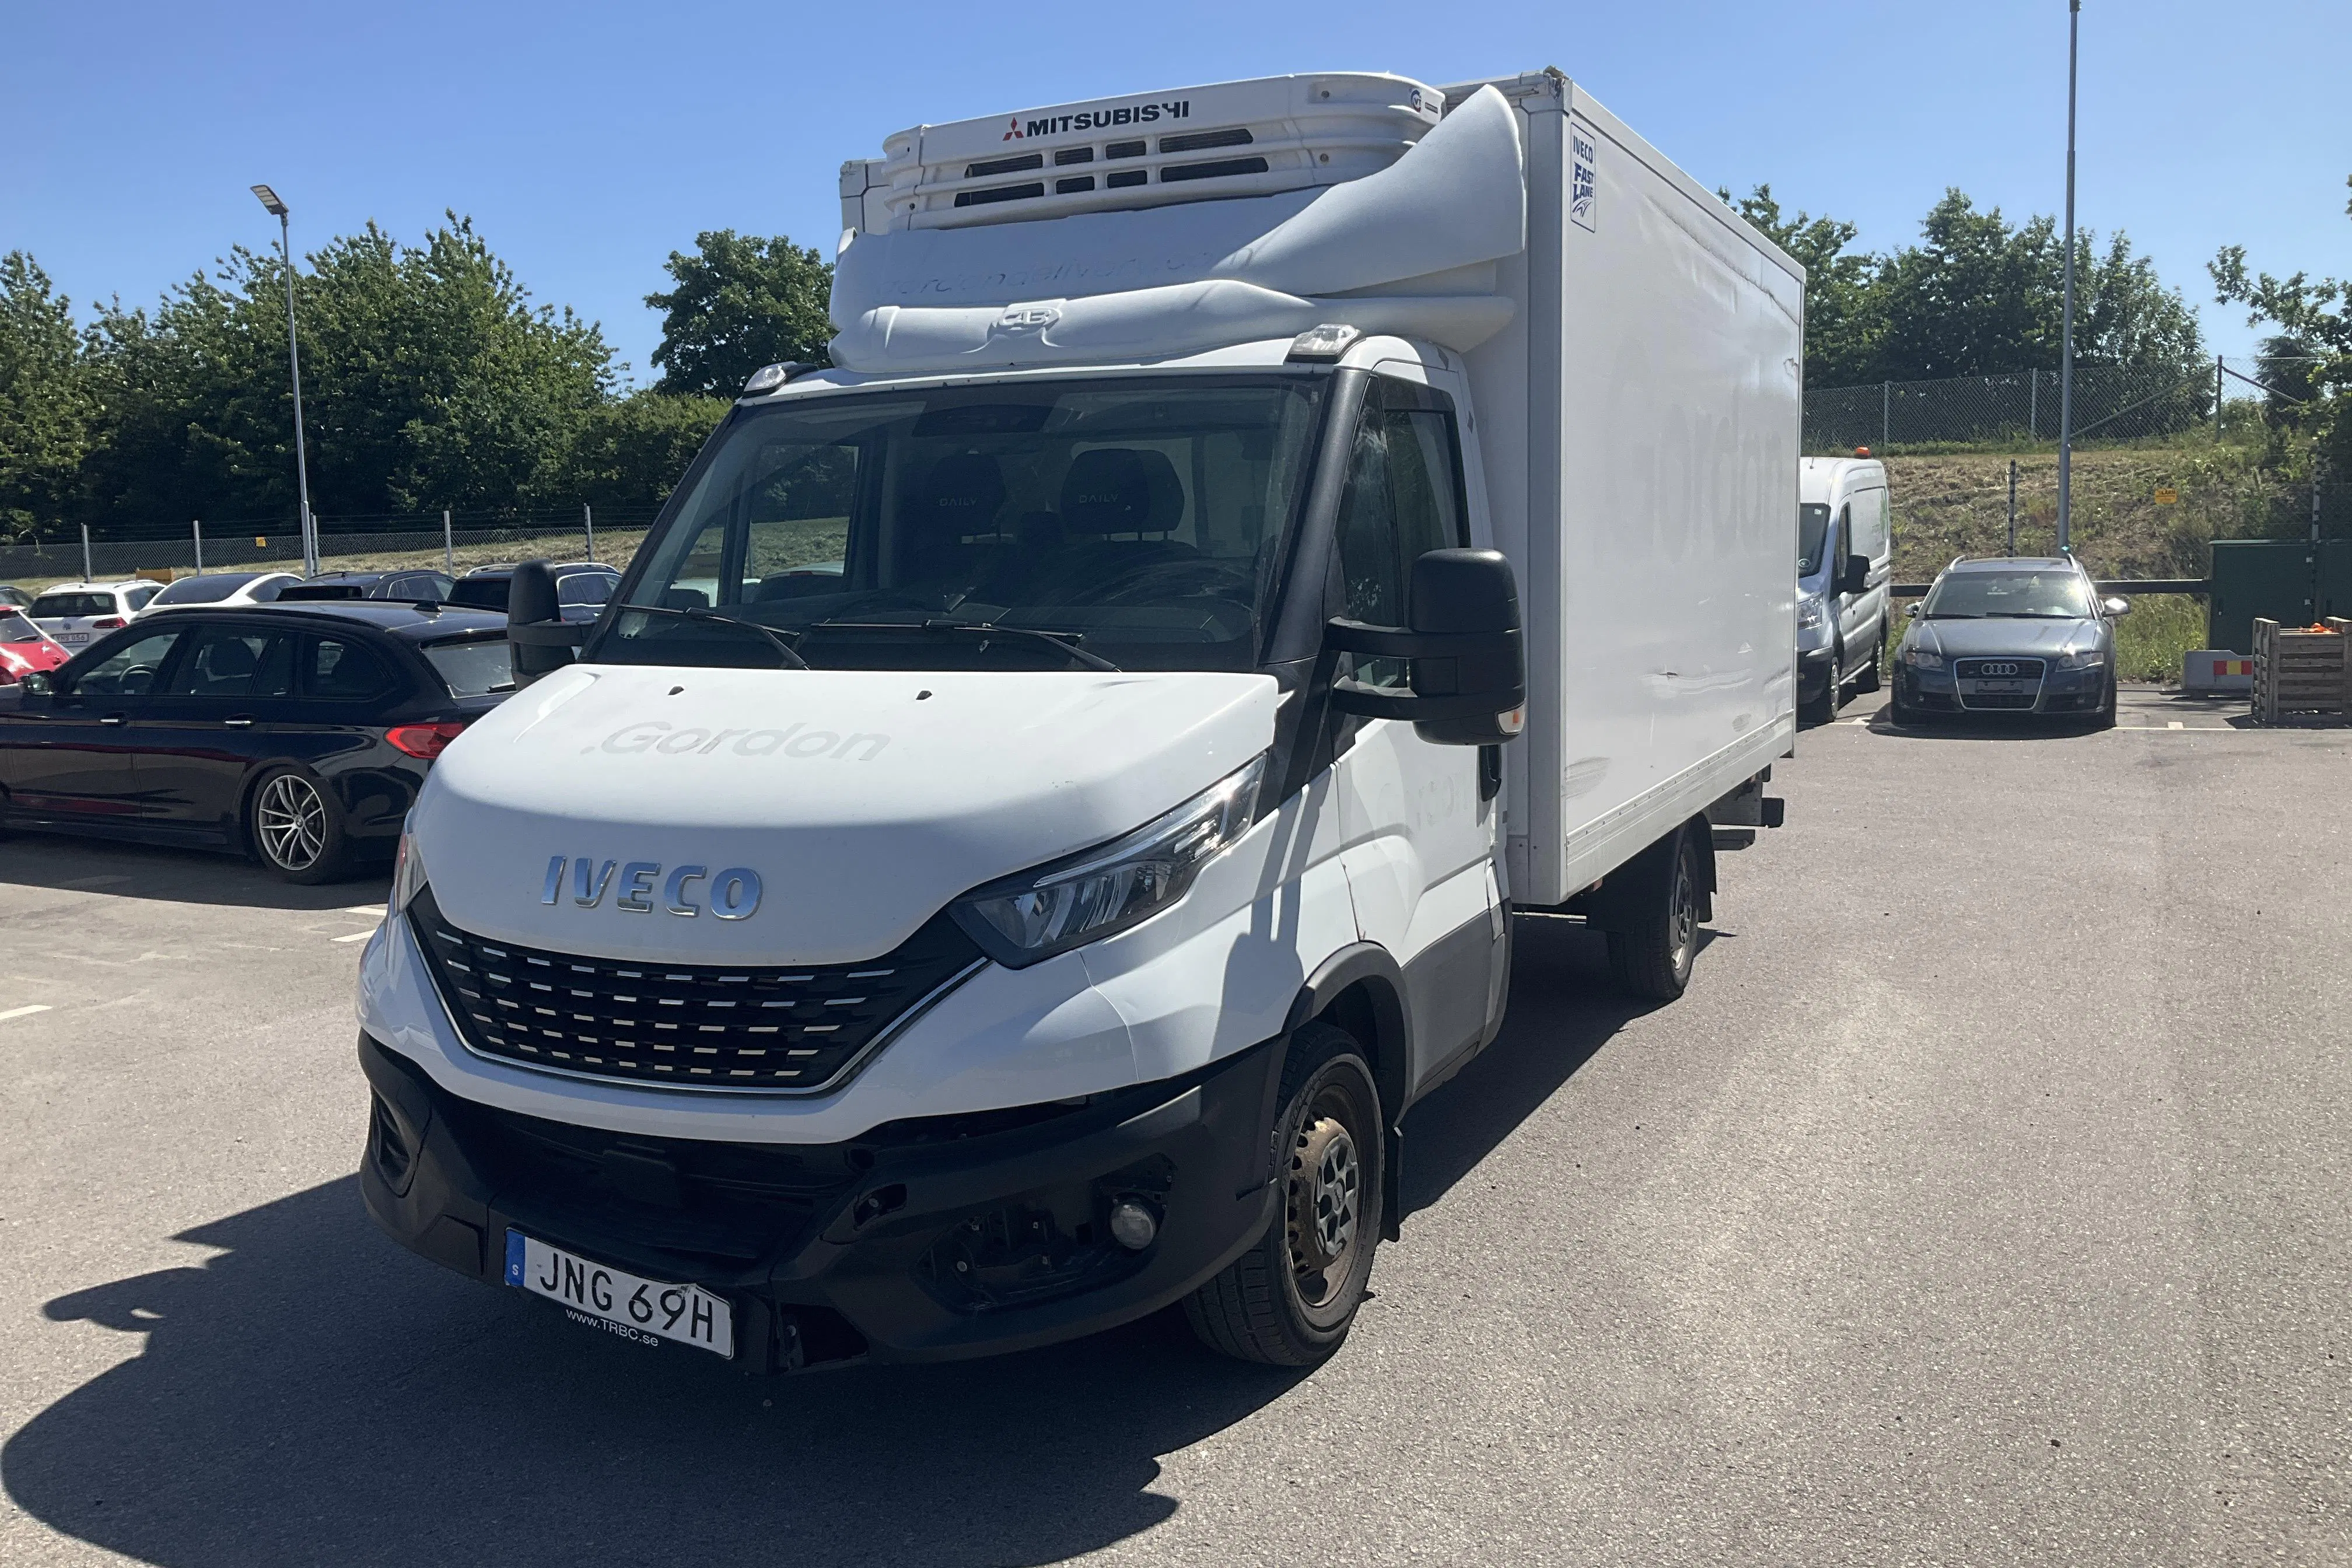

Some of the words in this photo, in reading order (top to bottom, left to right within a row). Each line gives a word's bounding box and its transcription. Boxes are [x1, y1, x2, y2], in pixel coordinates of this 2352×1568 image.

[1573, 135, 1593, 164] IVECO
[1574, 161, 1594, 184] FAST
[1573, 184, 1593, 204] LANE
[939, 498, 978, 506] DAILY
[1079, 494, 1119, 503] DAILY
[541, 855, 764, 921] IVECO
[512, 1264, 519, 1276] S
[540, 1252, 612, 1312] JNG
[628, 1283, 713, 1343] 69H
[566, 1308, 659, 1347] www.TRBC.se
